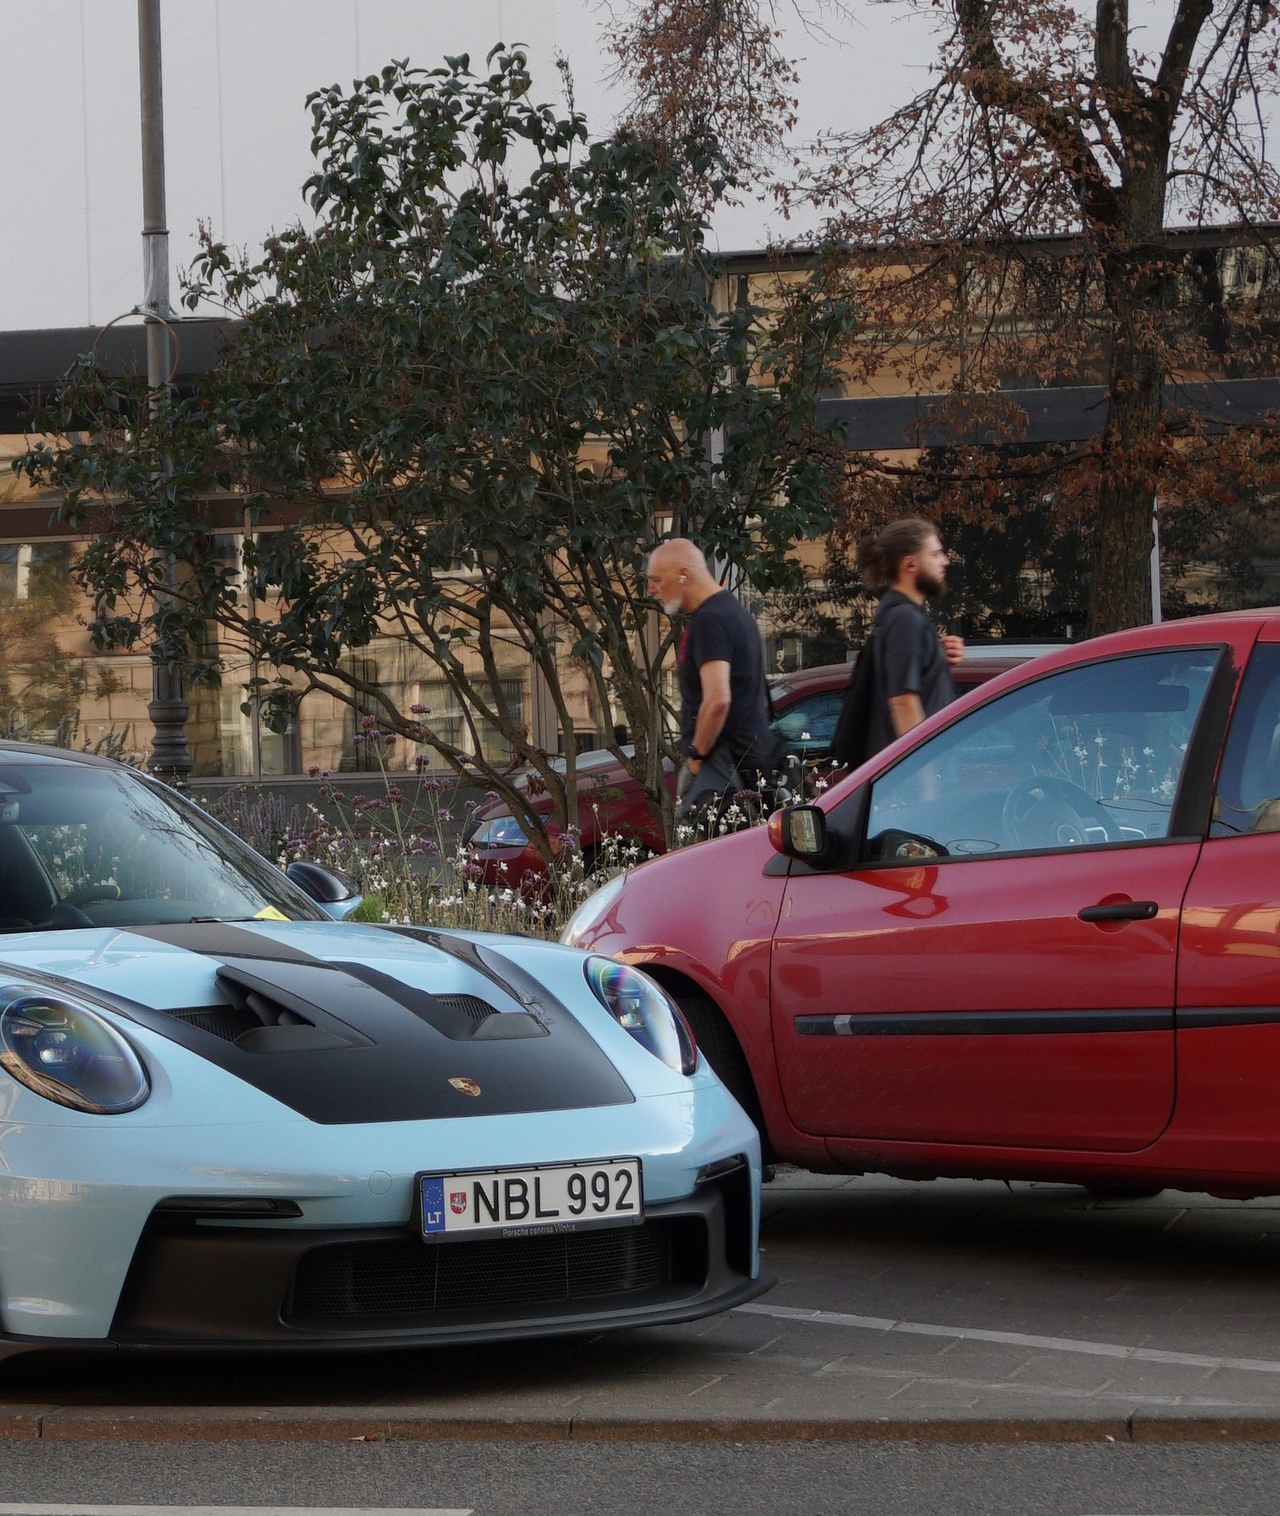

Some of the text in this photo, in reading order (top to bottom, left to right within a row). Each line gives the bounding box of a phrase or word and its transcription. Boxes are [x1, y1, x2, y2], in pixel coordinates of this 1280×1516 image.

[473, 1167, 634, 1224] NBL 992
[427, 1210, 442, 1226] LT
[502, 1227, 529, 1238] Porsche
[529, 1225, 553, 1236] centras
